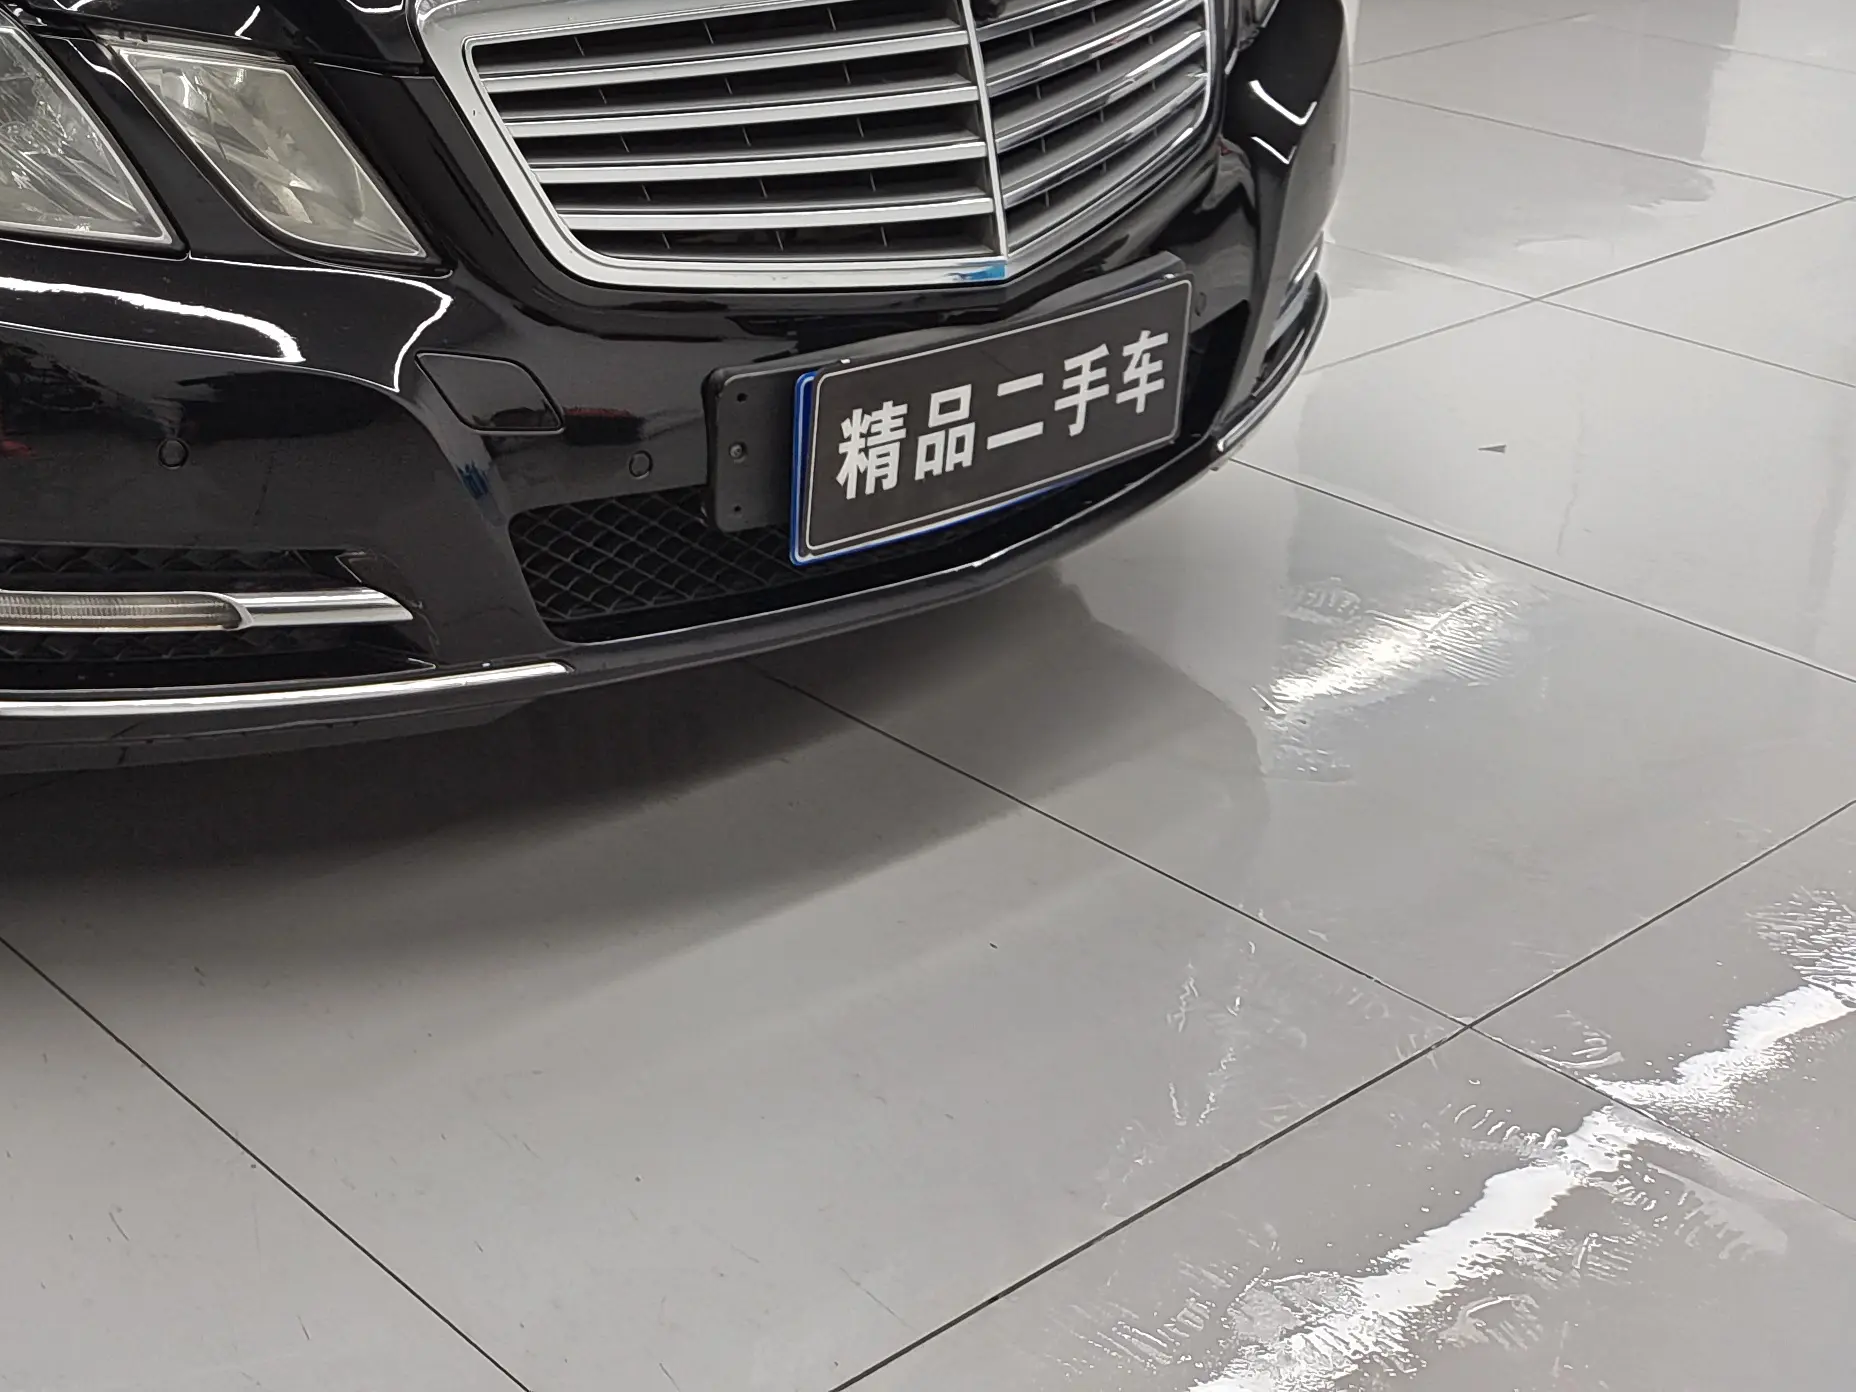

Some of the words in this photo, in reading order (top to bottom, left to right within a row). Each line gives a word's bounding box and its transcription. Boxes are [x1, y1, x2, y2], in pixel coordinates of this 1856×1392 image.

[836, 330, 1169, 500] 精品二手车
